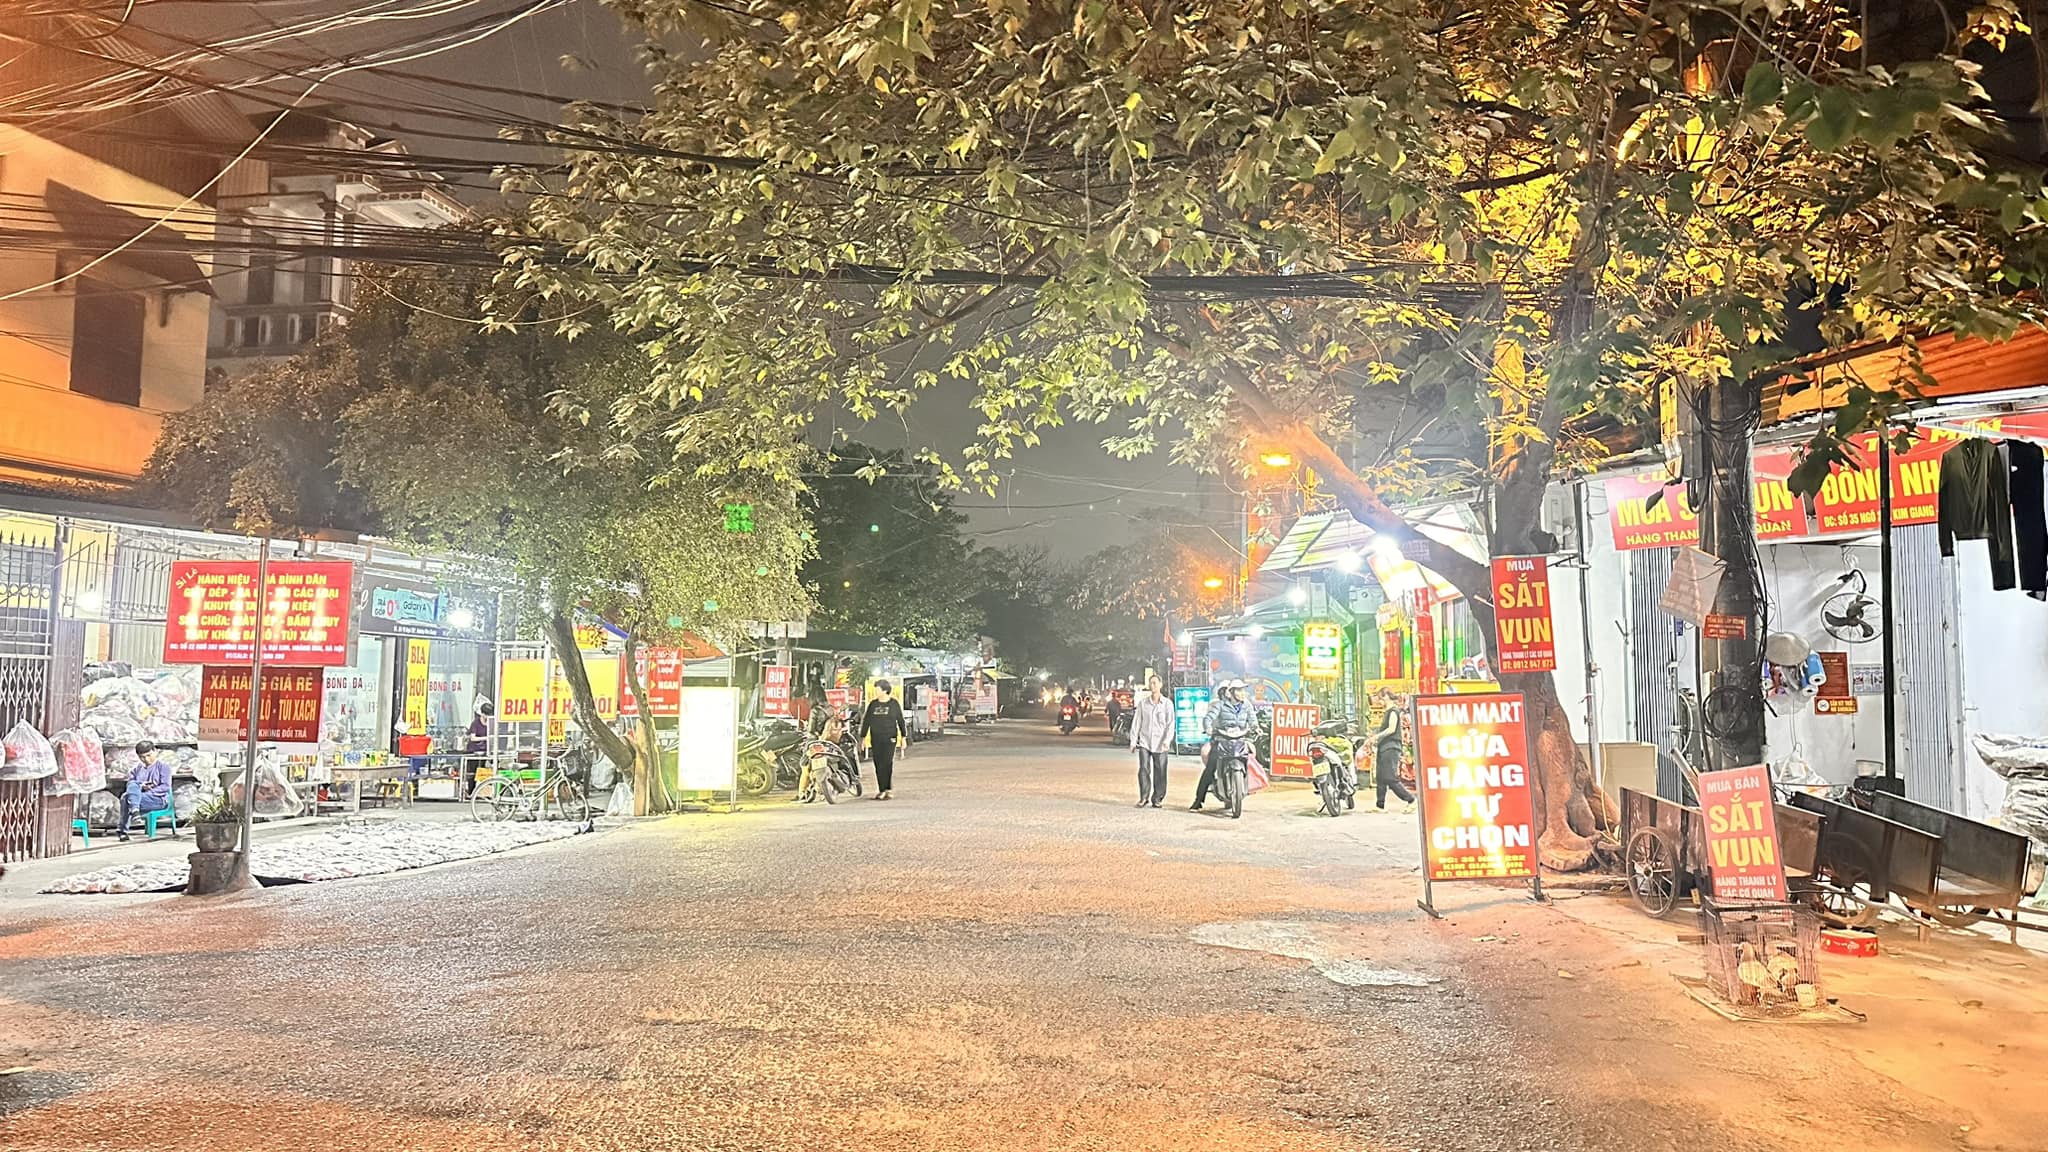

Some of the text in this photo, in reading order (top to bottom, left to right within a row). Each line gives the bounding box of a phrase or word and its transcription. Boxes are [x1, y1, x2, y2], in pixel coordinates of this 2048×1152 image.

[1821, 457, 1894, 506] ĐỒN
[1616, 495, 1673, 528] MUA
[1753, 479, 1794, 520] ỤN
[1892, 508, 1910, 520] KIM
[1910, 504, 1935, 519] GIANG
[1626, 529, 1662, 545] HÀNG
[1506, 559, 1535, 572] MUA
[198, 573, 225, 585] HÀNG
[227, 573, 251, 587] HIỆU
[1499, 572, 1546, 609] SẮT
[1499, 616, 1552, 649] VỤN
[410, 645, 426, 665] BIA
[210, 670, 314, 692] XẢ HÀG GIÁ RẺ
[326, 673, 348, 689] BÓNG
[202, 692, 223, 719] GIÀY
[223, 693, 241, 720] DÉP
[278, 694, 293, 721] TÚI
[292, 695, 317, 721] XÁCH
[504, 698, 529, 716] BIA
[533, 697, 558, 716] HI
[1472, 701, 1521, 724] MART
[1276, 707, 1317, 730] GAME
[1437, 728, 1510, 760] CỬA
[1284, 765, 1304, 776] 10m
[1706, 775, 1760, 794] MUA BÁN
[1708, 792, 1764, 834] SẮT
[1711, 836, 1775, 873] VỤN
